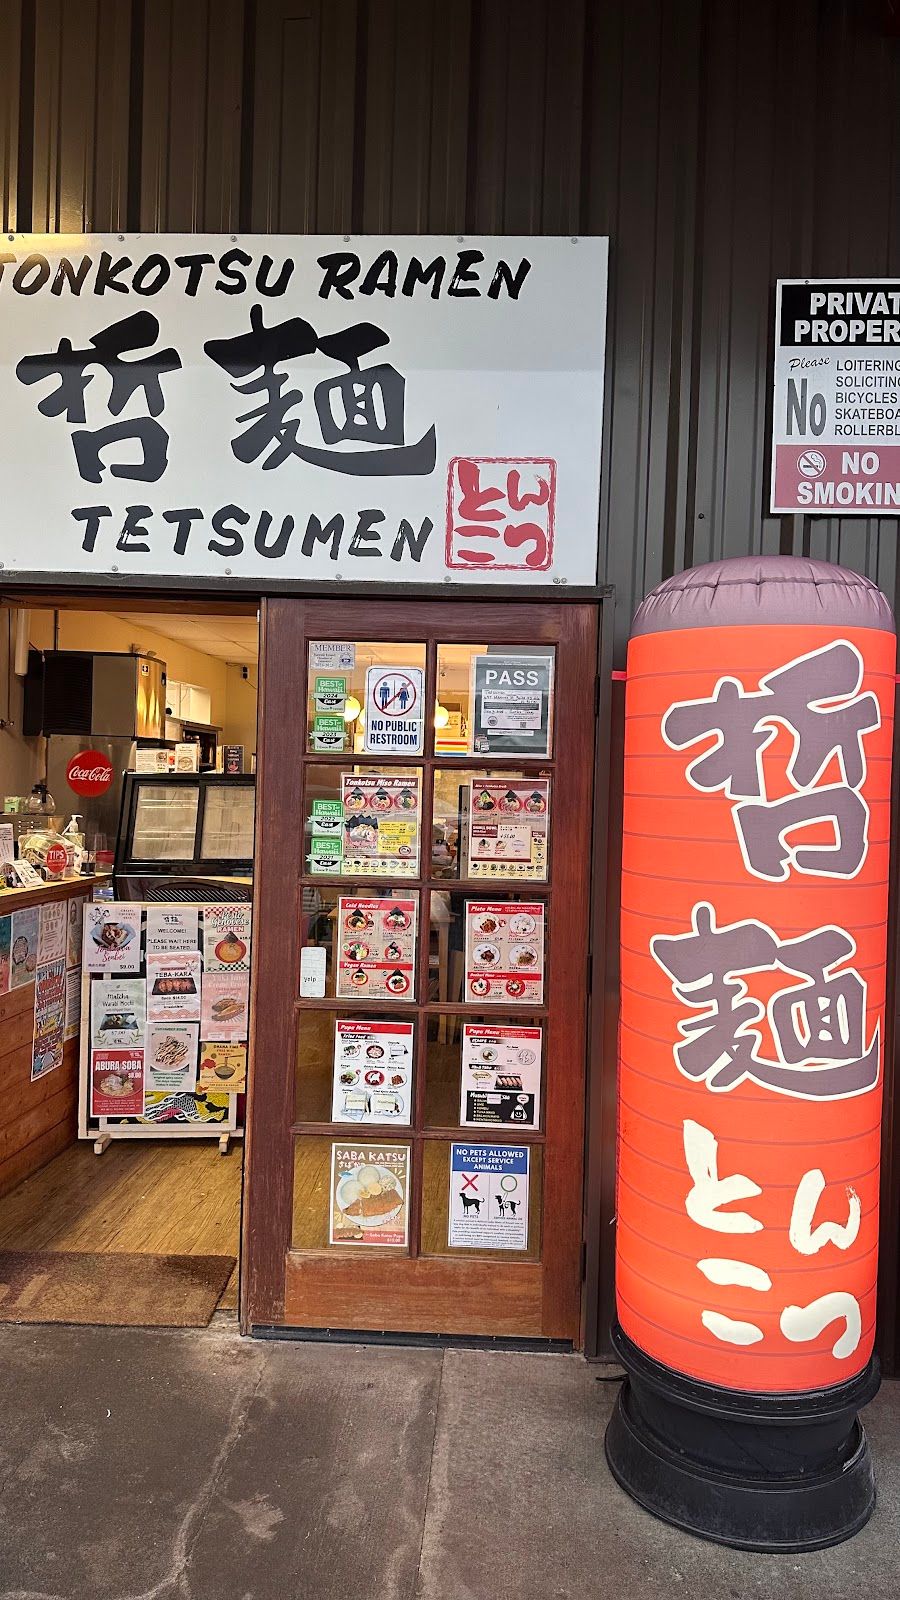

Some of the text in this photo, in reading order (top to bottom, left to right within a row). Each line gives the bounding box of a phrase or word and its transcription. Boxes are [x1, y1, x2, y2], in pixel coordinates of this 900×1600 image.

[317, 249, 532, 301] RAMEN
[809, 292, 900, 315] PRIVAT
[794, 319, 900, 343] PROPER
[789, 357, 830, 372] Please
[835, 375, 900, 388] SOLICITIN
[835, 392, 898, 404] BICYCLES
[786, 378, 827, 437] No
[834, 424, 900, 436] ROLLERBL
[841, 451, 880, 475] NO
[796, 481, 900, 505] SMOKIN
[71, 504, 434, 562] TETSUMEN
[314, 643, 352, 652] MEMBER
[485, 669, 539, 686] PASS
[371, 720, 417, 732] NO PUBLIC
[370, 733, 418, 745] RESTROOM
[68, 765, 113, 782] Coca-Cola
[345, 778, 376, 786] Tonkotsu
[393, 779, 416, 787] Ramen
[49, 850, 64, 860] TIPS
[95, 1060, 142, 1071] ABURA SOBA
[336, 1150, 406, 1162] SABA KATSU
[456, 1148, 524, 1158] NO PETS ALLOWED
[487, 1157, 514, 1165] SERVICE
